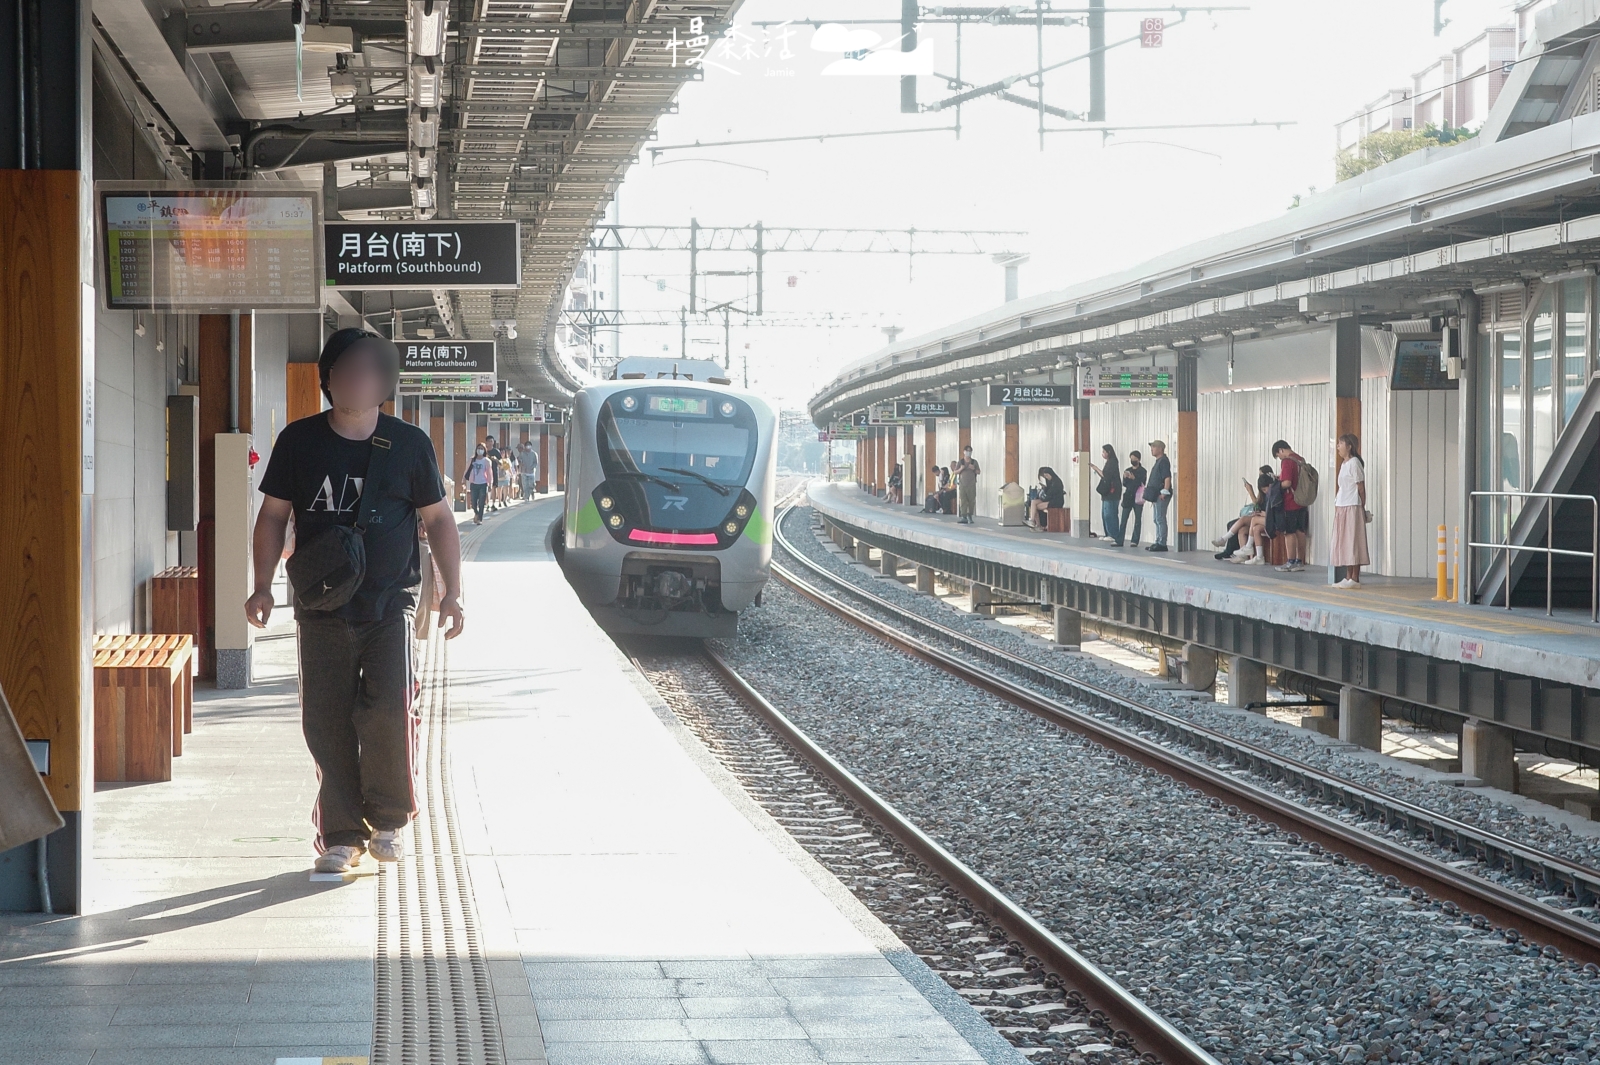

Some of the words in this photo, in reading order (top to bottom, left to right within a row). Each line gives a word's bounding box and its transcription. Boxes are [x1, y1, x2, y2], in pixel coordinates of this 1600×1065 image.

[1145, 18, 1162, 31] 68
[1144, 34, 1162, 47] 42
[147, 199, 173, 218] 平鎮
[338, 230, 462, 260] 月台(南下)
[338, 261, 392, 274] Platform
[396, 260, 482, 276] (Southbound)
[406, 345, 468, 360] 月台(南下)
[434, 360, 478, 368] (Southbound)
[1085, 367, 1091, 376] 2
[1002, 387, 1012, 402] 2
[1013, 387, 1054, 397] 月台(北上)
[905, 404, 912, 415] 2
[860, 416, 866, 424] 2
